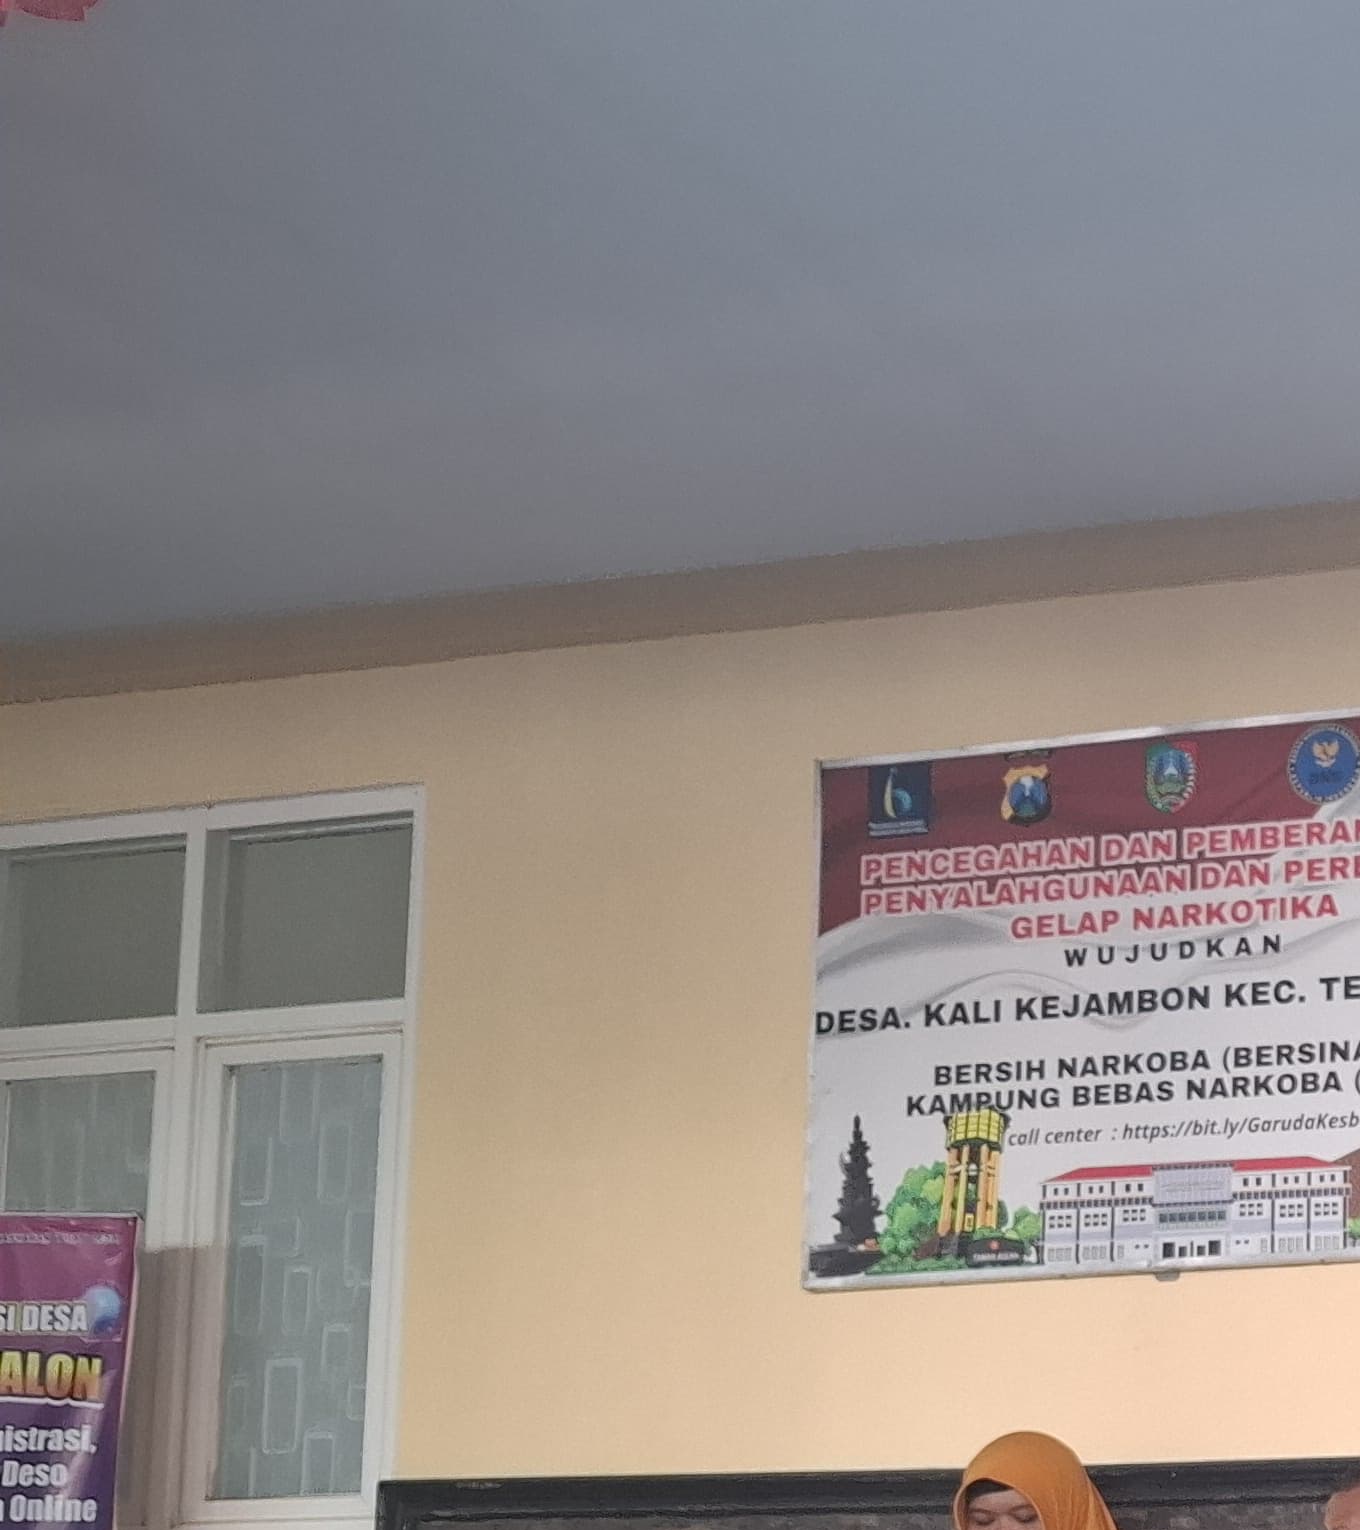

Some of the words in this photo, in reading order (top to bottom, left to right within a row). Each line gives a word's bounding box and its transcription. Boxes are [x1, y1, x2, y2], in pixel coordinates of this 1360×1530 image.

[863, 838, 1092, 883] PENCEGAHAN
[1102, 830, 1174, 864] DAN
[863, 867, 1189, 916] PENYALAHGUNAAN
[1201, 862, 1272, 892] DAN
[1010, 909, 1120, 940] GELAP
[1132, 893, 1339, 931] NARKOTIKA
[1064, 934, 1281, 968] WUJUDKAN
[816, 1006, 911, 1035] DESA.
[924, 1000, 1002, 1028] KALI
[1015, 985, 1211, 1021] KEJAMBON
[1224, 979, 1306, 1008] KEC.
[934, 1059, 1046, 1086] BERSIH
[1057, 1049, 1211, 1079] NARKOBA
[906, 1087, 1061, 1117] KAMPUNG
[1072, 1081, 1175, 1107] BEBAS
[1186, 1071, 1344, 1101] NARKOBA
[1008, 1128, 1040, 1147] call
[1045, 1128, 1103, 1145] center
[21, 1304, 88, 1332] DESA
[9, 1494, 97, 1522] Online
